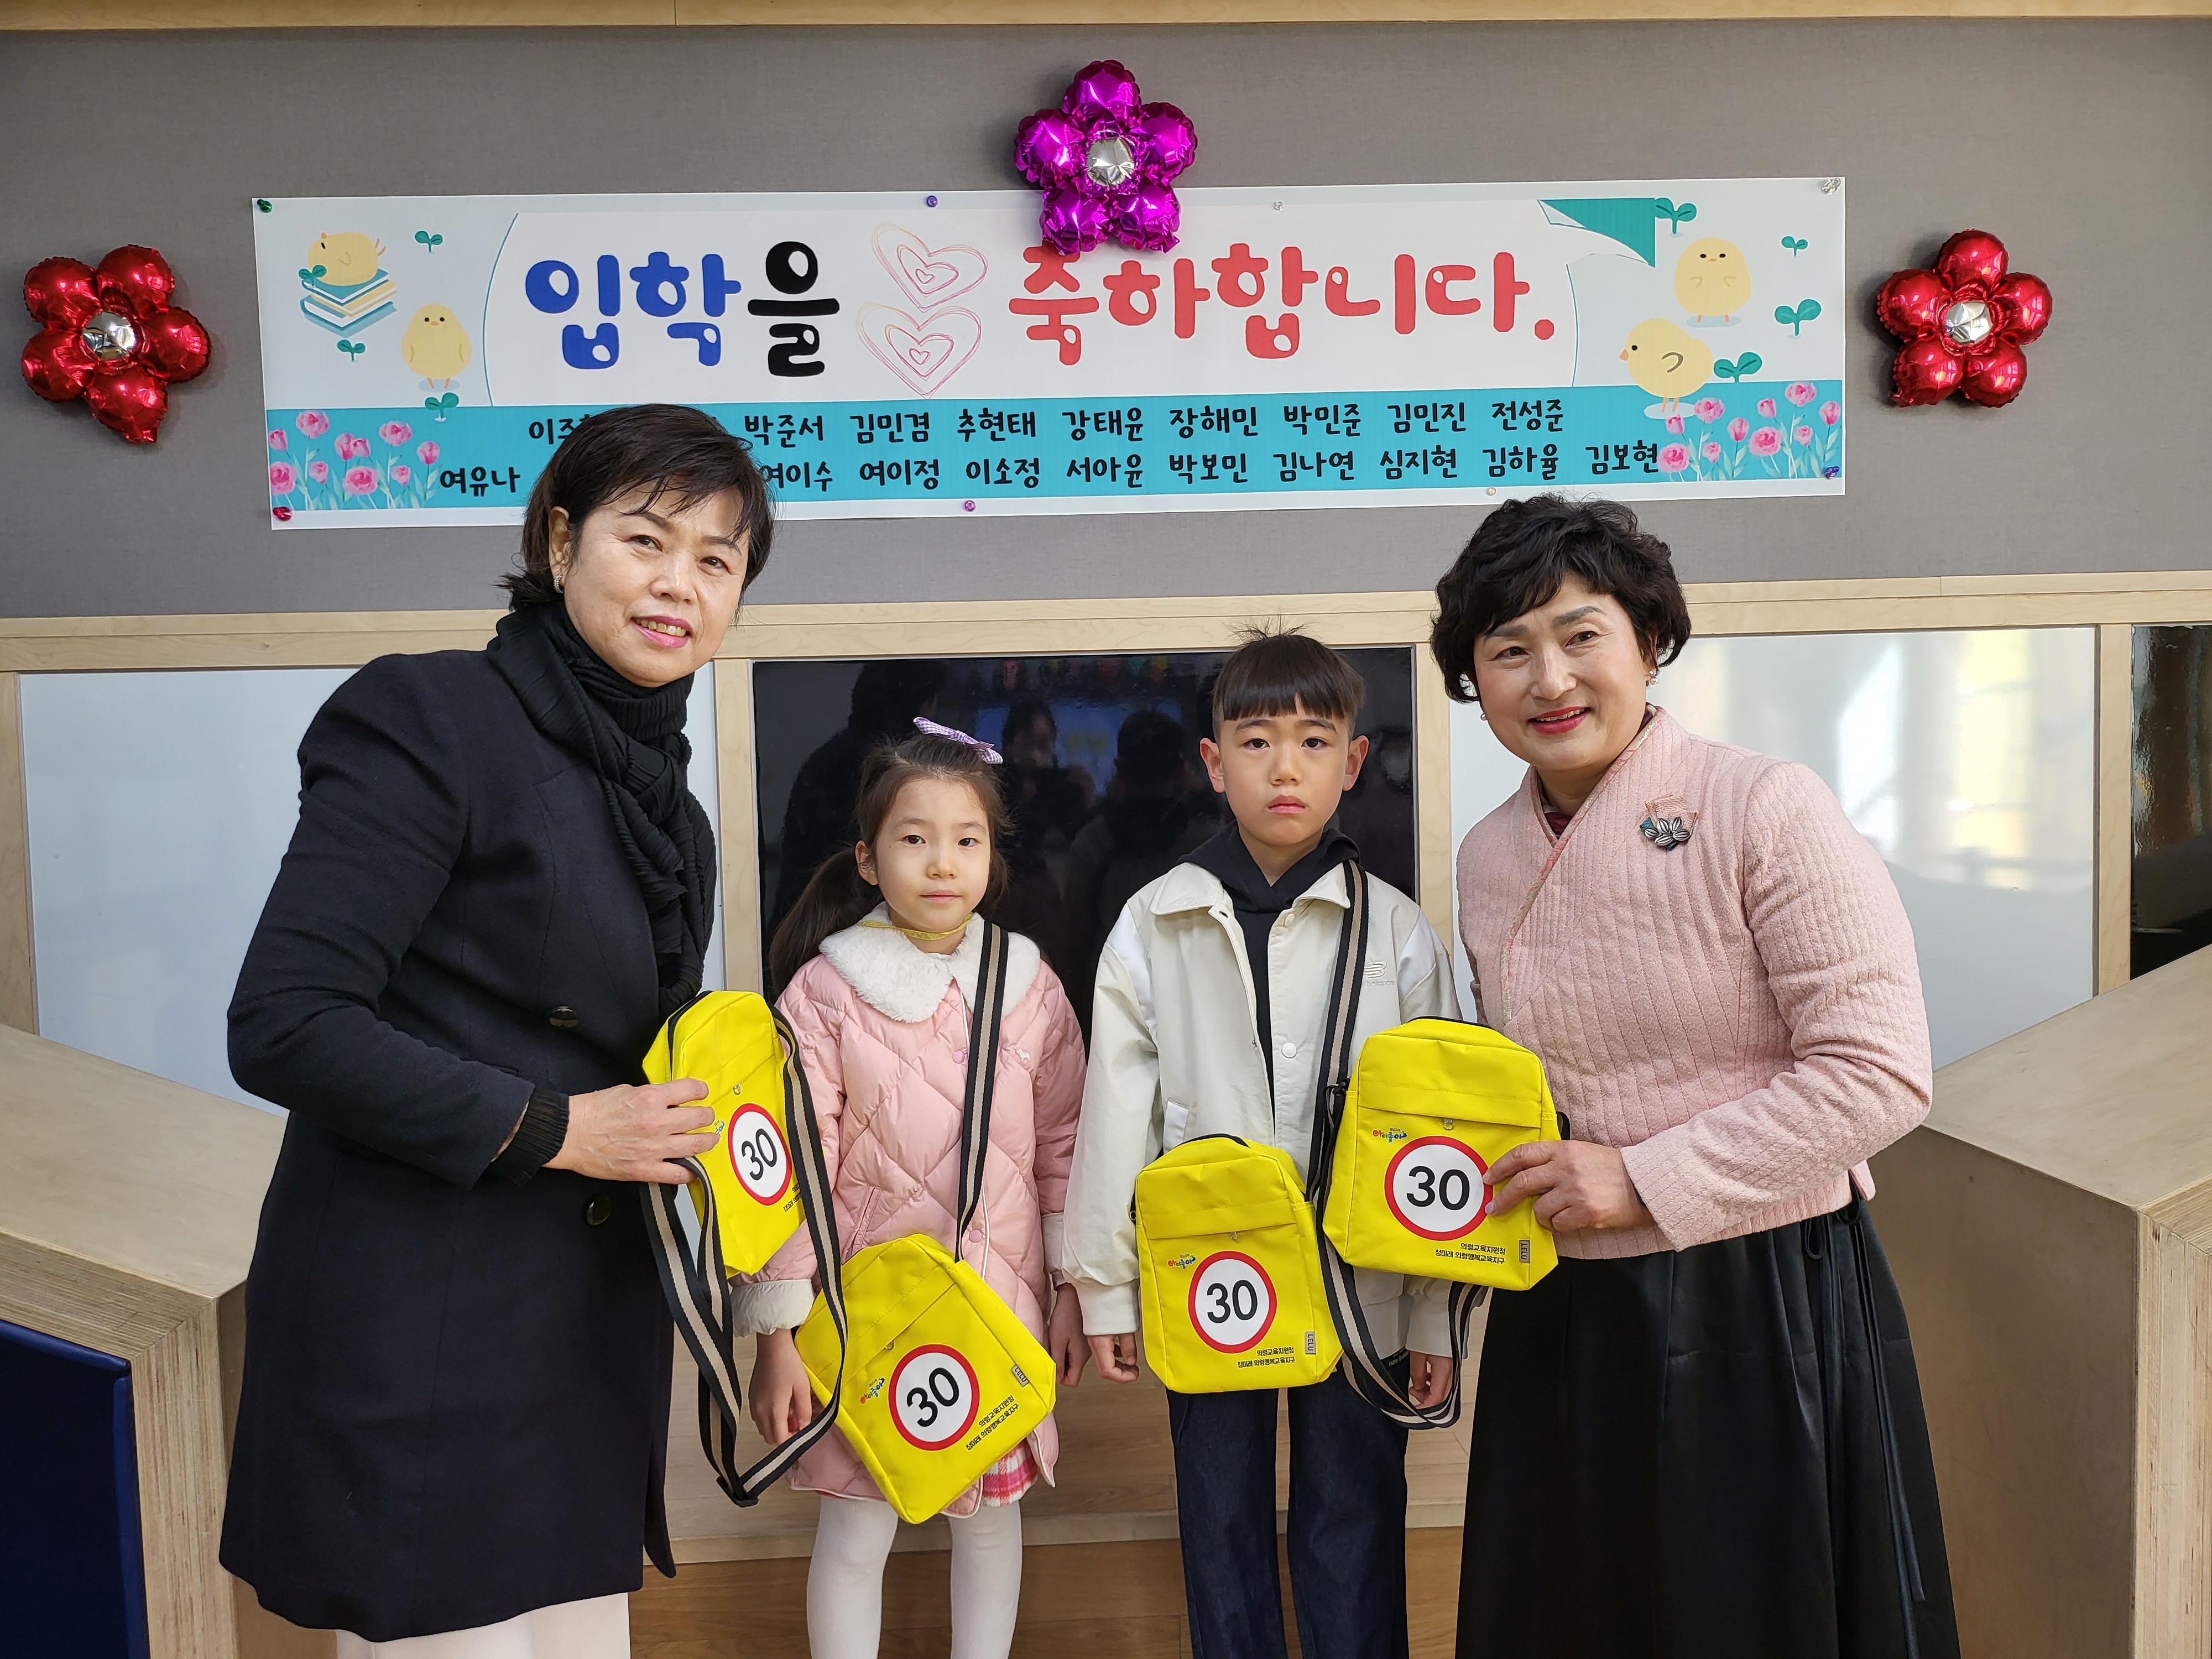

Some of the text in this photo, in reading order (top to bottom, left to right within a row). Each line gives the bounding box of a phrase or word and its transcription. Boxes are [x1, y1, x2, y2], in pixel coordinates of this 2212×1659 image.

[525, 241, 1554, 377] 입학을 축하합니다.
[744, 415, 823, 448] 박준서
[850, 413, 930, 444] 김민겸
[958, 408, 1036, 442] 추현태
[1062, 407, 1144, 442] 강태윤
[1170, 406, 1259, 439] 장해민
[1284, 404, 1361, 437] 박민준
[1387, 402, 1467, 434] 김민진
[1492, 399, 1564, 432] 전성준
[440, 440, 1659, 497] 여유나 여이수 여이정 이소정 서아윤 박보민 김나연 심지현 김하율 김보현
[741, 1128, 778, 1181] 30
[1406, 1166, 1470, 1211] 30
[1207, 1280, 1258, 1324] 30
[906, 1368, 960, 1427] 30
